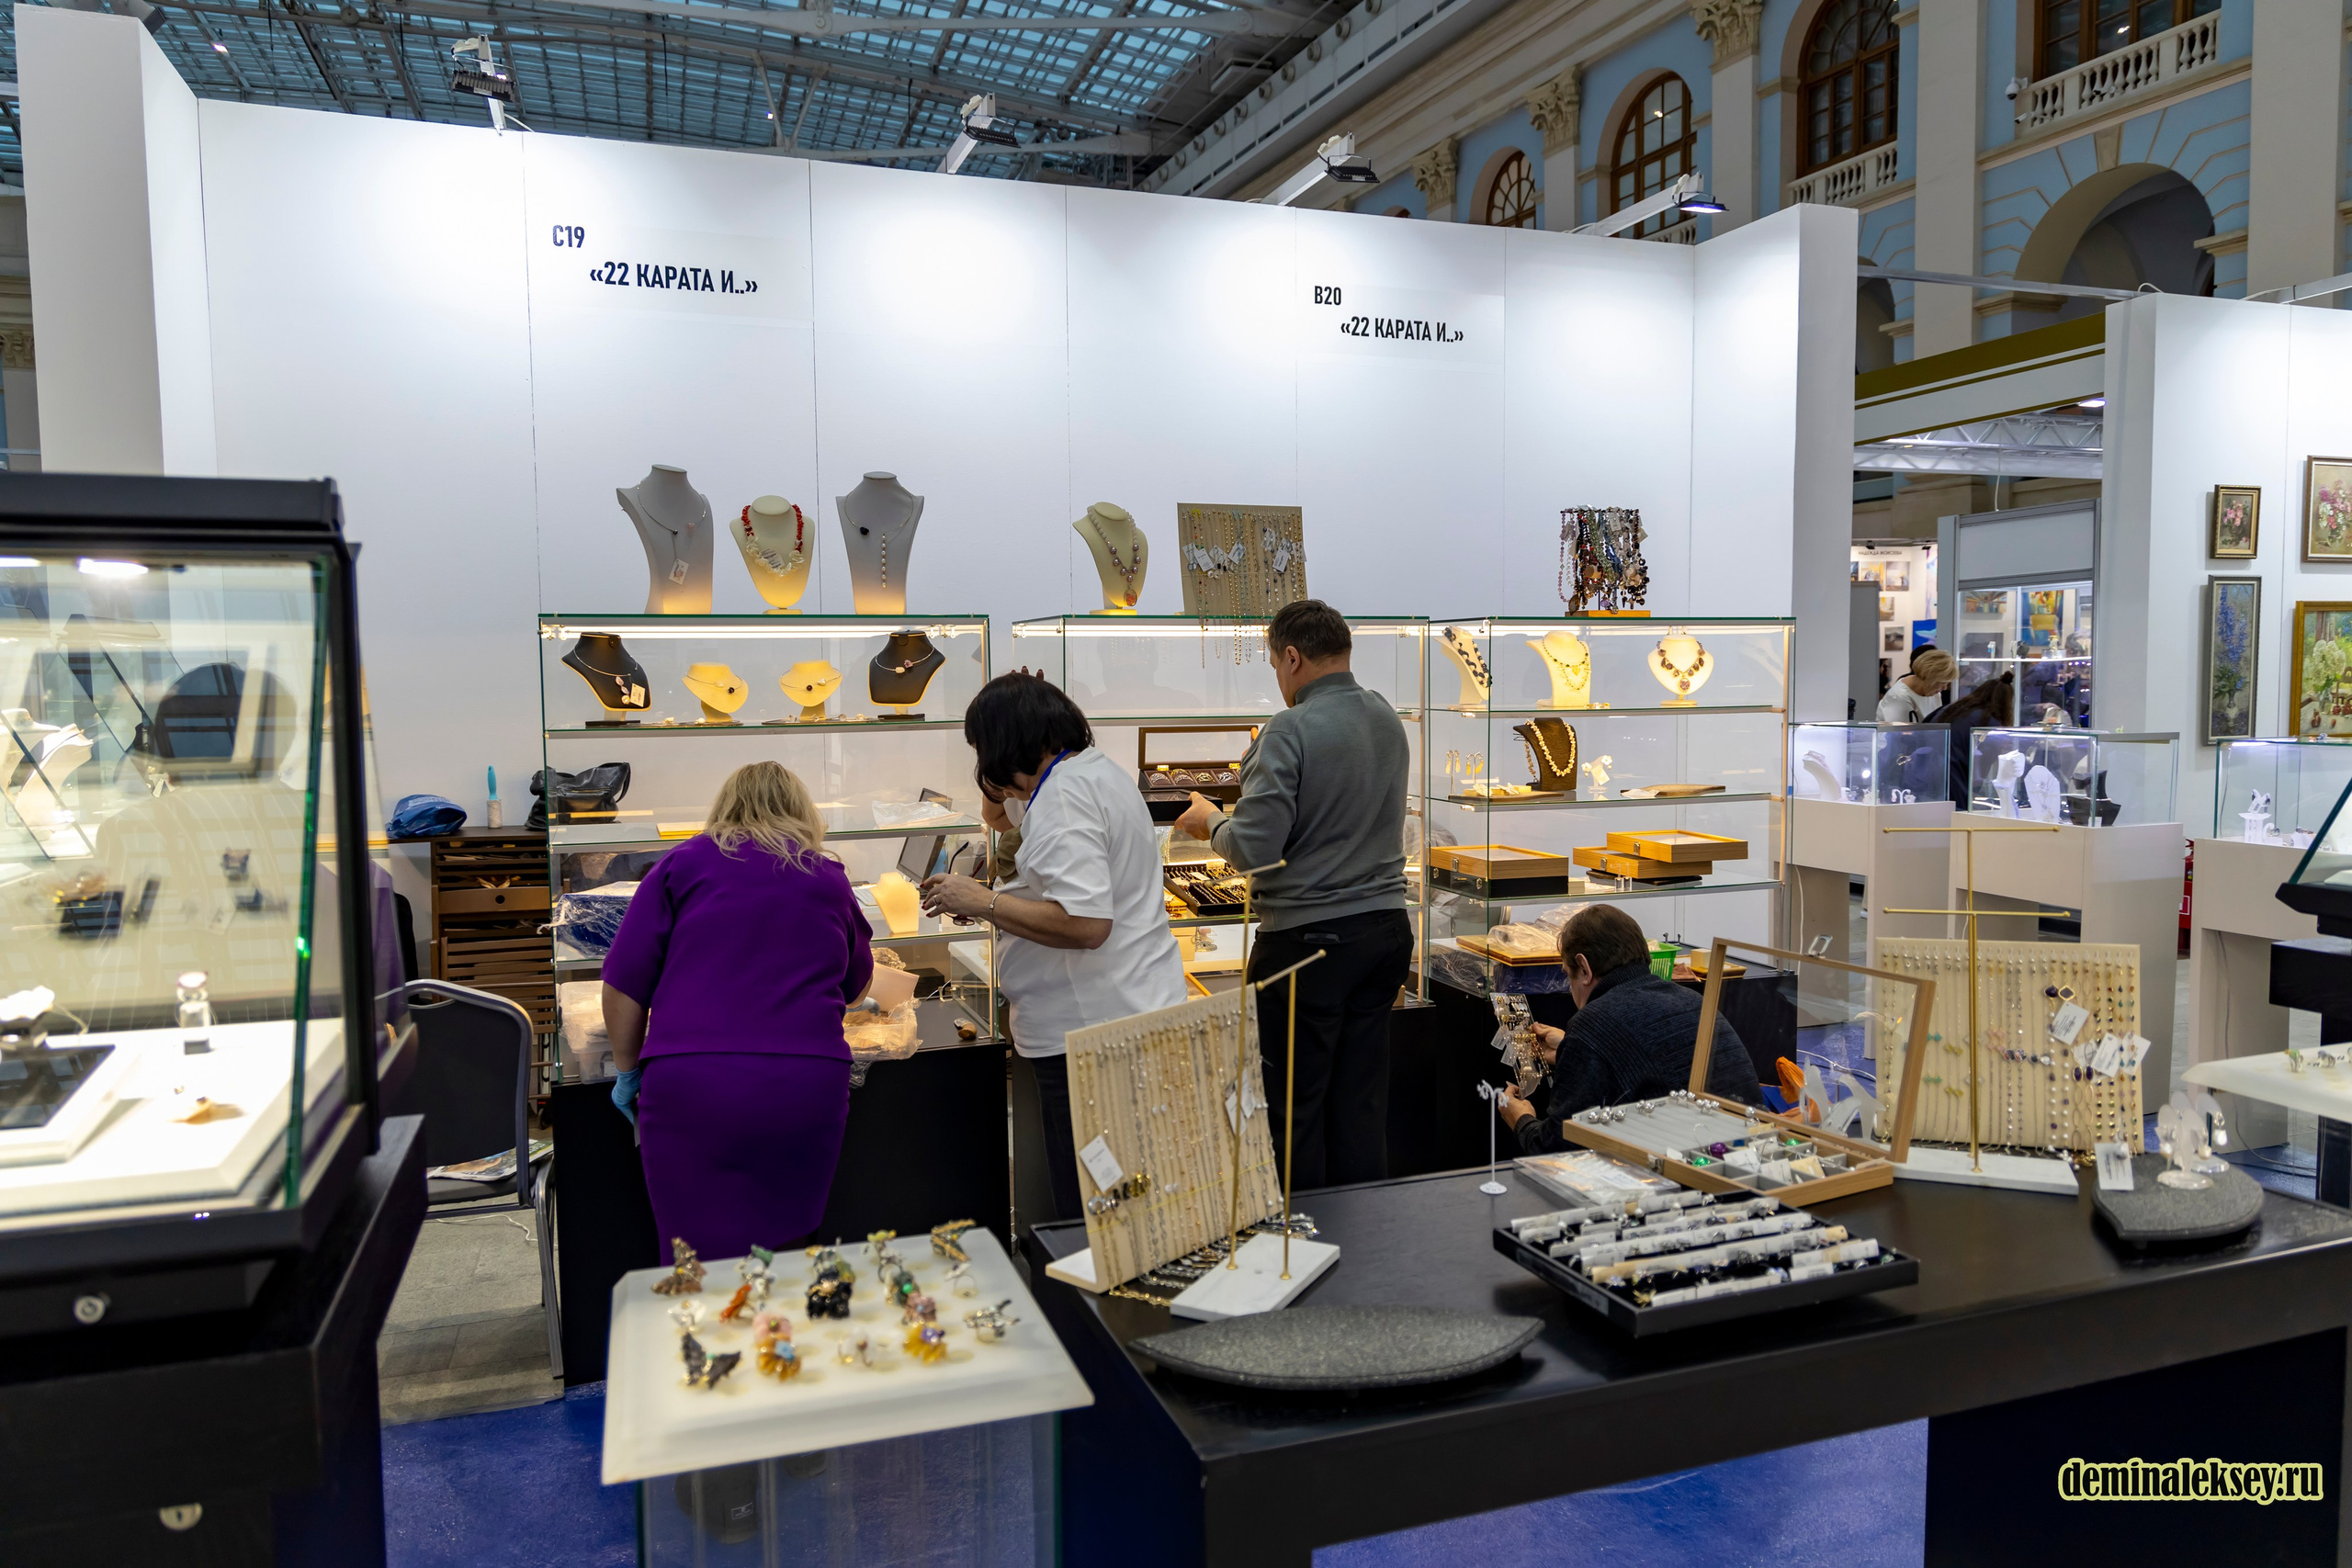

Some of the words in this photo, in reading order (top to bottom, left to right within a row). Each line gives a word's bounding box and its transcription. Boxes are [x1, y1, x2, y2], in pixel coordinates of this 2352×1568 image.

[552, 224, 585, 248] C19
[589, 261, 630, 286] «22
[636, 263, 715, 292] КАРАТА
[1314, 285, 1342, 306] B20
[1340, 316, 1370, 337] «22
[1374, 317, 1431, 342] КАРАТА
